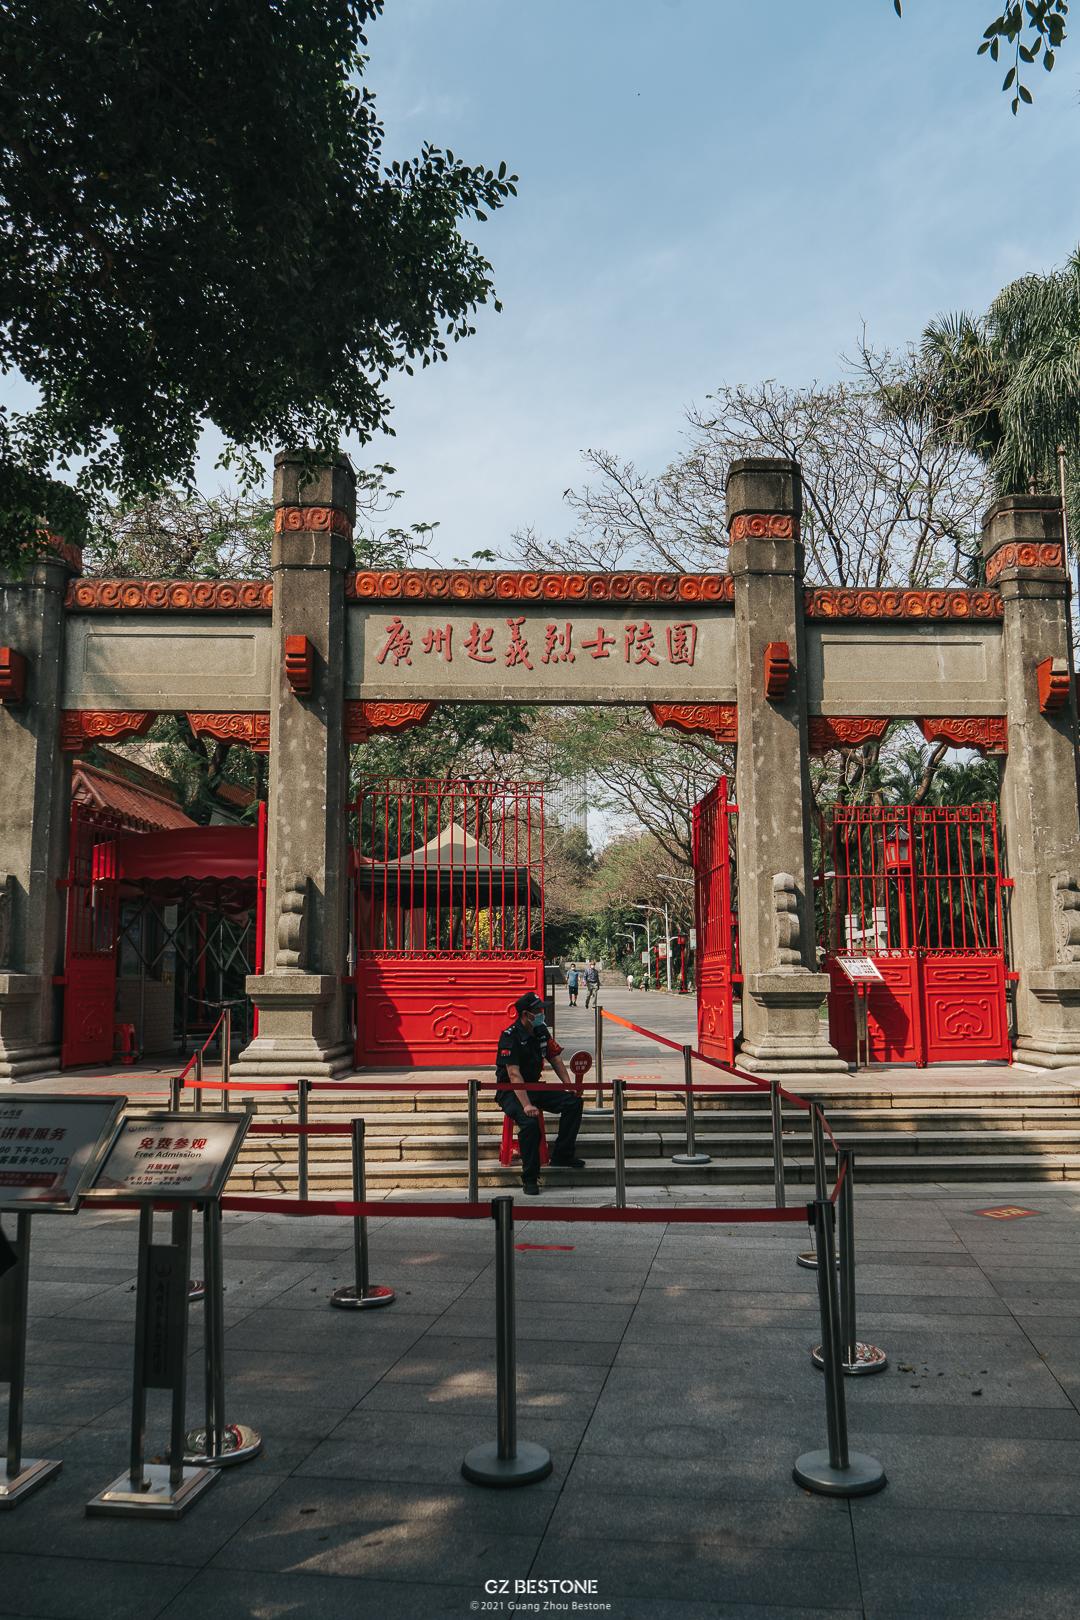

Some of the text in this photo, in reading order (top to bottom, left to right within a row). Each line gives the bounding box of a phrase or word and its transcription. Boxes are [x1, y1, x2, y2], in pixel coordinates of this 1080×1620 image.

[376, 616, 698, 670] 廣州起義烈士陵園
[0, 1127, 67, 1140] 讲解服务
[138, 1137, 207, 1149] 免费参观
